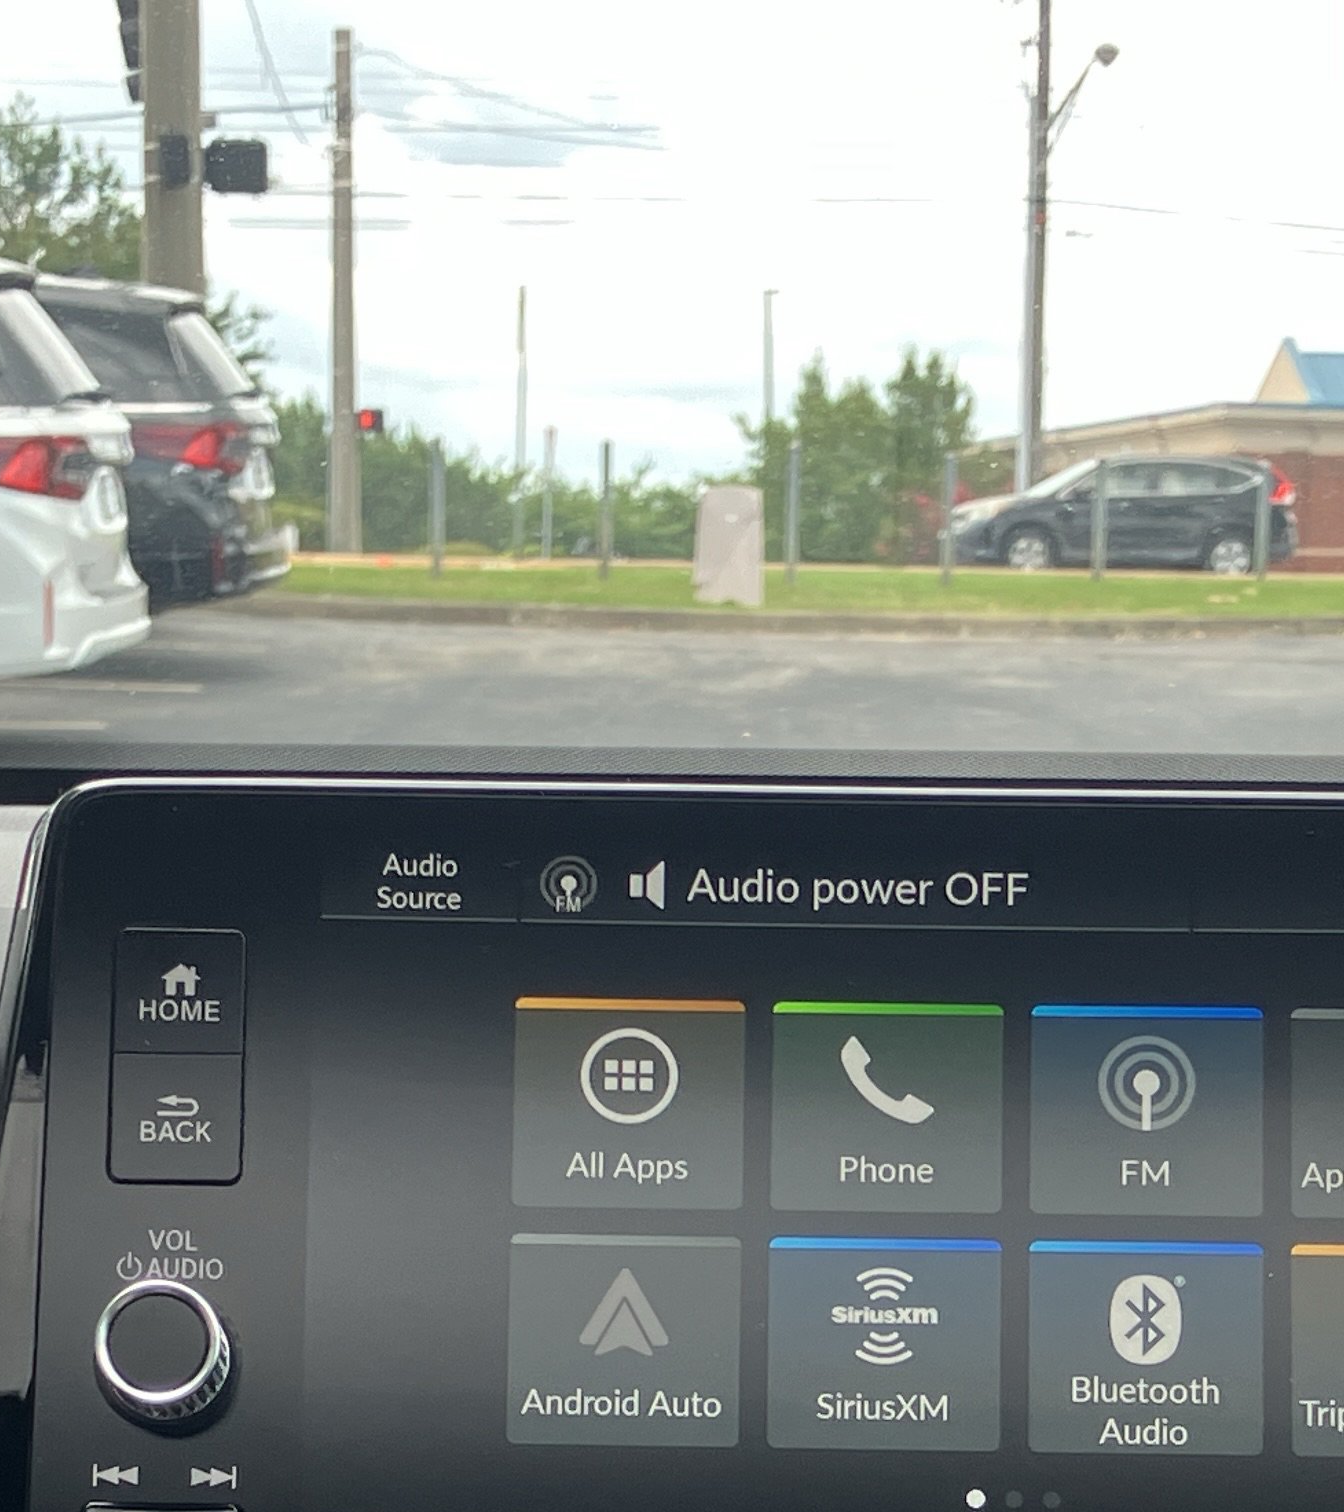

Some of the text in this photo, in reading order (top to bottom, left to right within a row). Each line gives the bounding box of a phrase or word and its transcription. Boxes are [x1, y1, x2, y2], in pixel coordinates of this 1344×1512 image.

[382, 852, 458, 877] Audio
[376, 885, 462, 910] Source
[687, 868, 1029, 911] Audio power OFF
[555, 895, 582, 913] FM
[139, 999, 221, 1022] HOME
[139, 1120, 212, 1143] BACK
[565, 1151, 688, 1185] All Apps
[840, 1155, 934, 1183] Phone
[1121, 1159, 1170, 1187] FM
[148, 1229, 198, 1252] VOL
[148, 1257, 224, 1280] AUDIO
[520, 1387, 722, 1418] Android Auto
[1071, 1375, 1220, 1405] Bluetooth
[816, 1392, 948, 1421] SiriusXM
[1099, 1417, 1188, 1446] Audio
